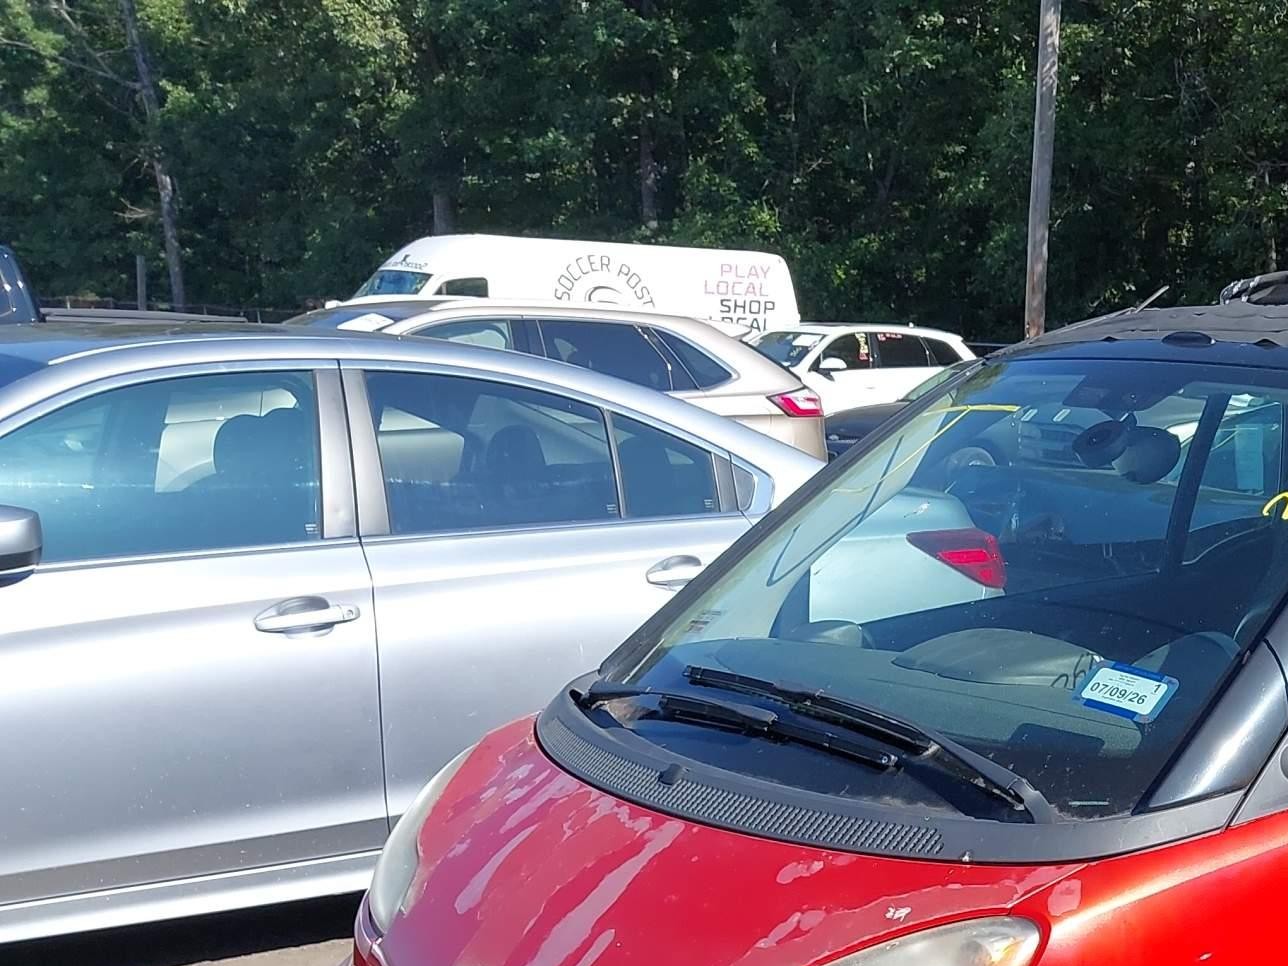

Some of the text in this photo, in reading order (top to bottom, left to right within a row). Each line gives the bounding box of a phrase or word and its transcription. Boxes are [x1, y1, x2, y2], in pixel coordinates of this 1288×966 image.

[720, 263, 771, 279] PLAY
[554, 254, 656, 308] SOCCER POST
[704, 279, 769, 297] LOCAL
[719, 298, 776, 315] SHOP
[1089, 681, 1148, 705] 07/09/26
